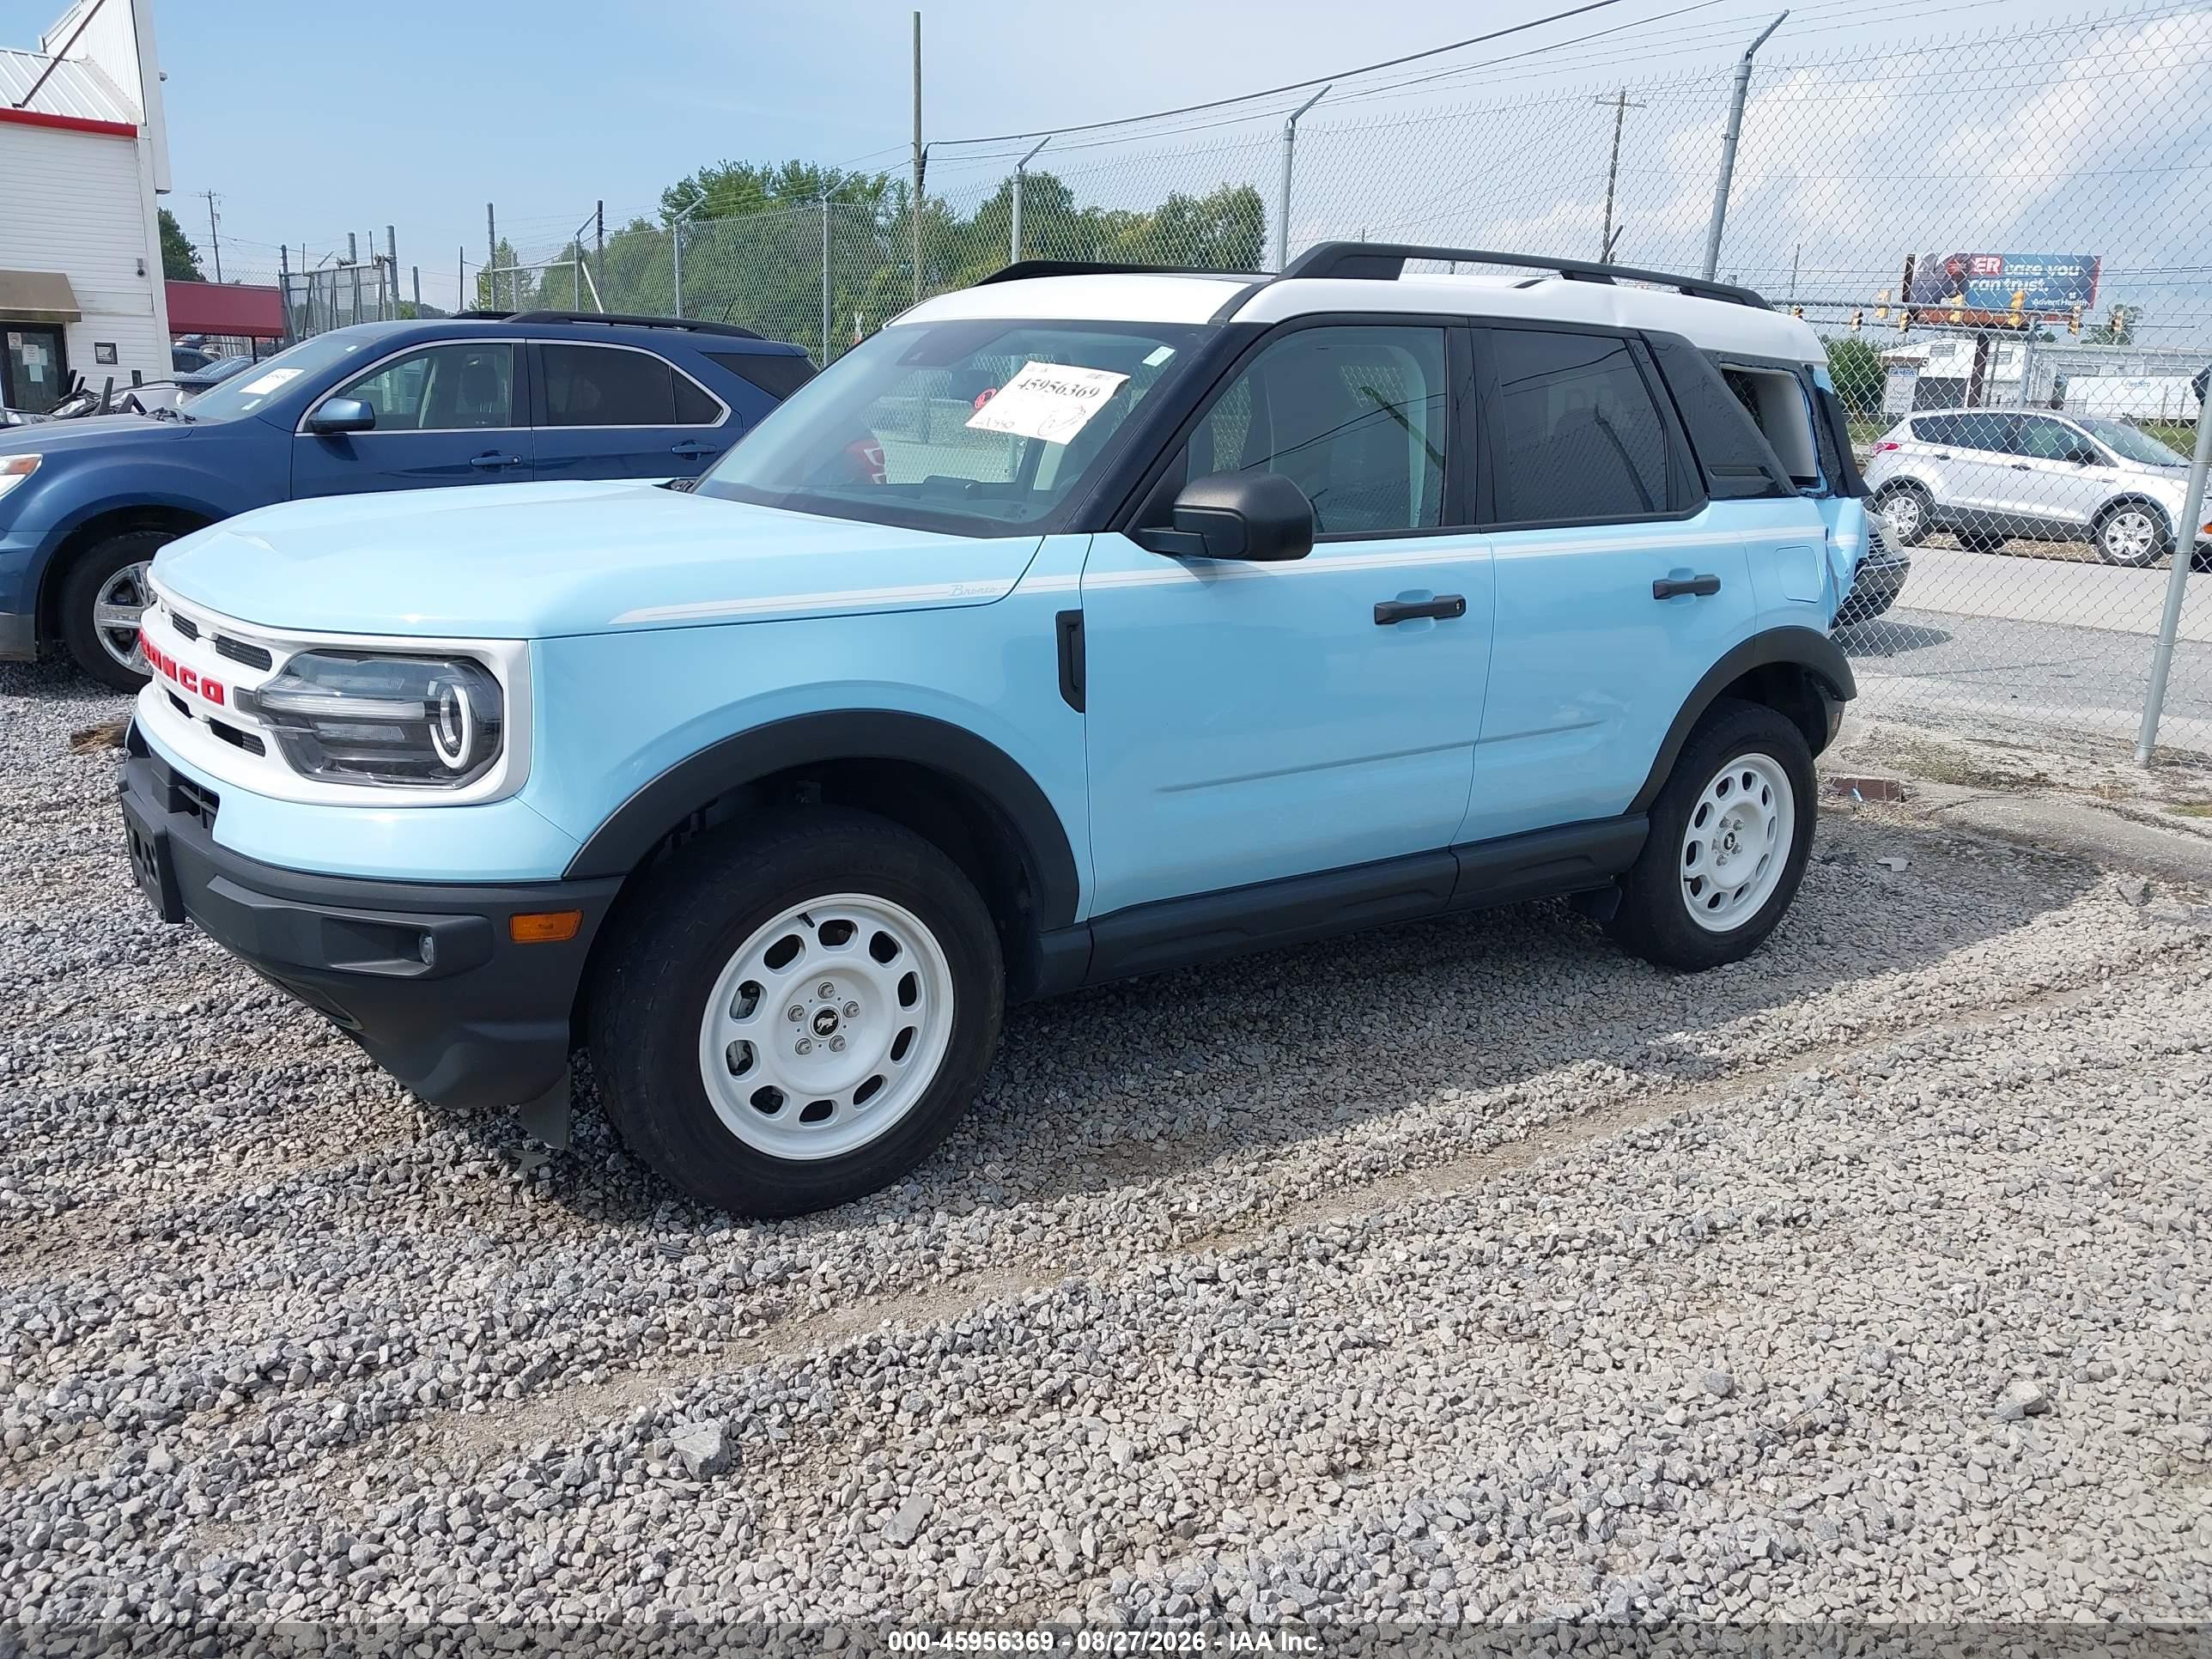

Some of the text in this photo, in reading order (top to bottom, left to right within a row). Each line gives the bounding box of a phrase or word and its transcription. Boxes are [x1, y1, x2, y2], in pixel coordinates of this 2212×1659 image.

[1973, 256, 2001, 273] ER
[2004, 264, 2043, 276] care
[2046, 264, 2081, 279] you
[1969, 277, 2050, 292] can trust.
[1018, 379, 1100, 399] 45956369
[948, 584, 998, 597] Bronco
